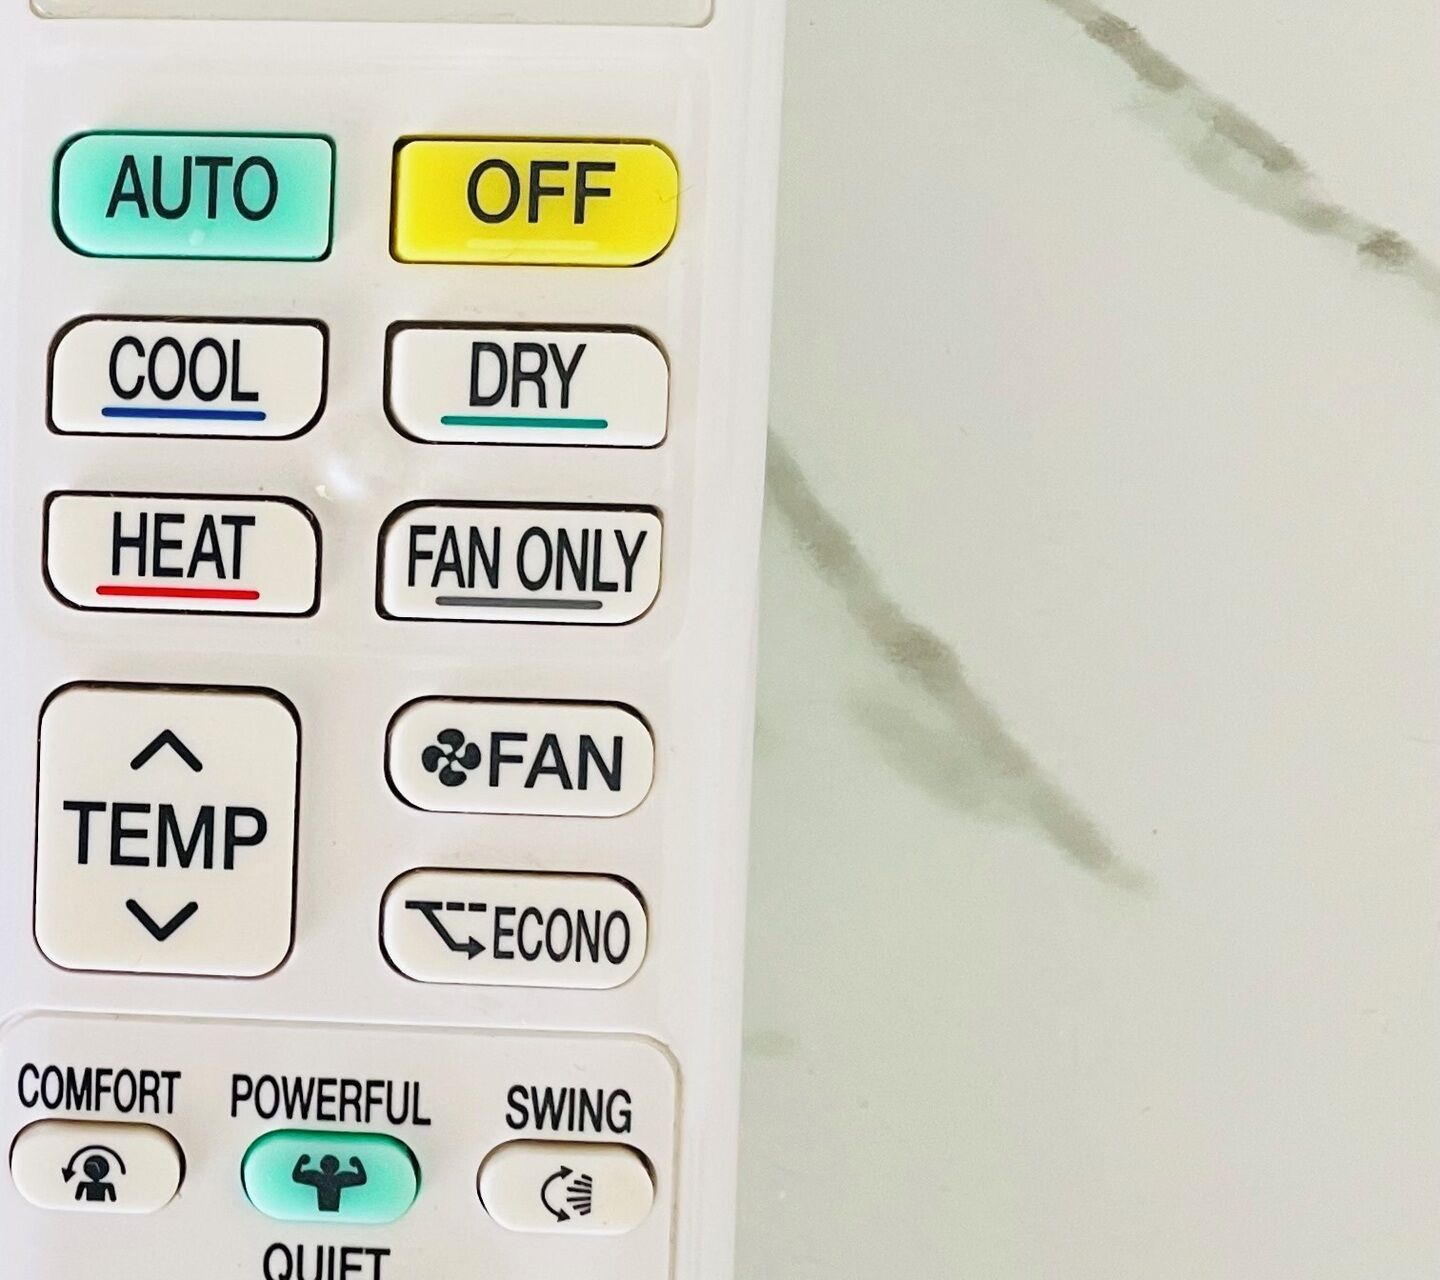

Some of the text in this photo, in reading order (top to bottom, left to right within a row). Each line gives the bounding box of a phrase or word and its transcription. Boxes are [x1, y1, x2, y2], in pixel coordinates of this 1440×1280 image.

[106, 155, 278, 221] AUTO
[468, 159, 615, 224] OFF
[109, 336, 258, 401] COOL
[470, 342, 586, 408] DRY
[112, 512, 255, 579] HEAT
[408, 525, 647, 592] FAN ONLY
[489, 732, 623, 791] FAN
[63, 801, 267, 870] TEMP
[494, 907, 630, 964] ECONO
[18, 1064, 182, 1115] COMFORT
[232, 1075, 432, 1126] POWERFUL
[506, 1085, 631, 1133] SWING
